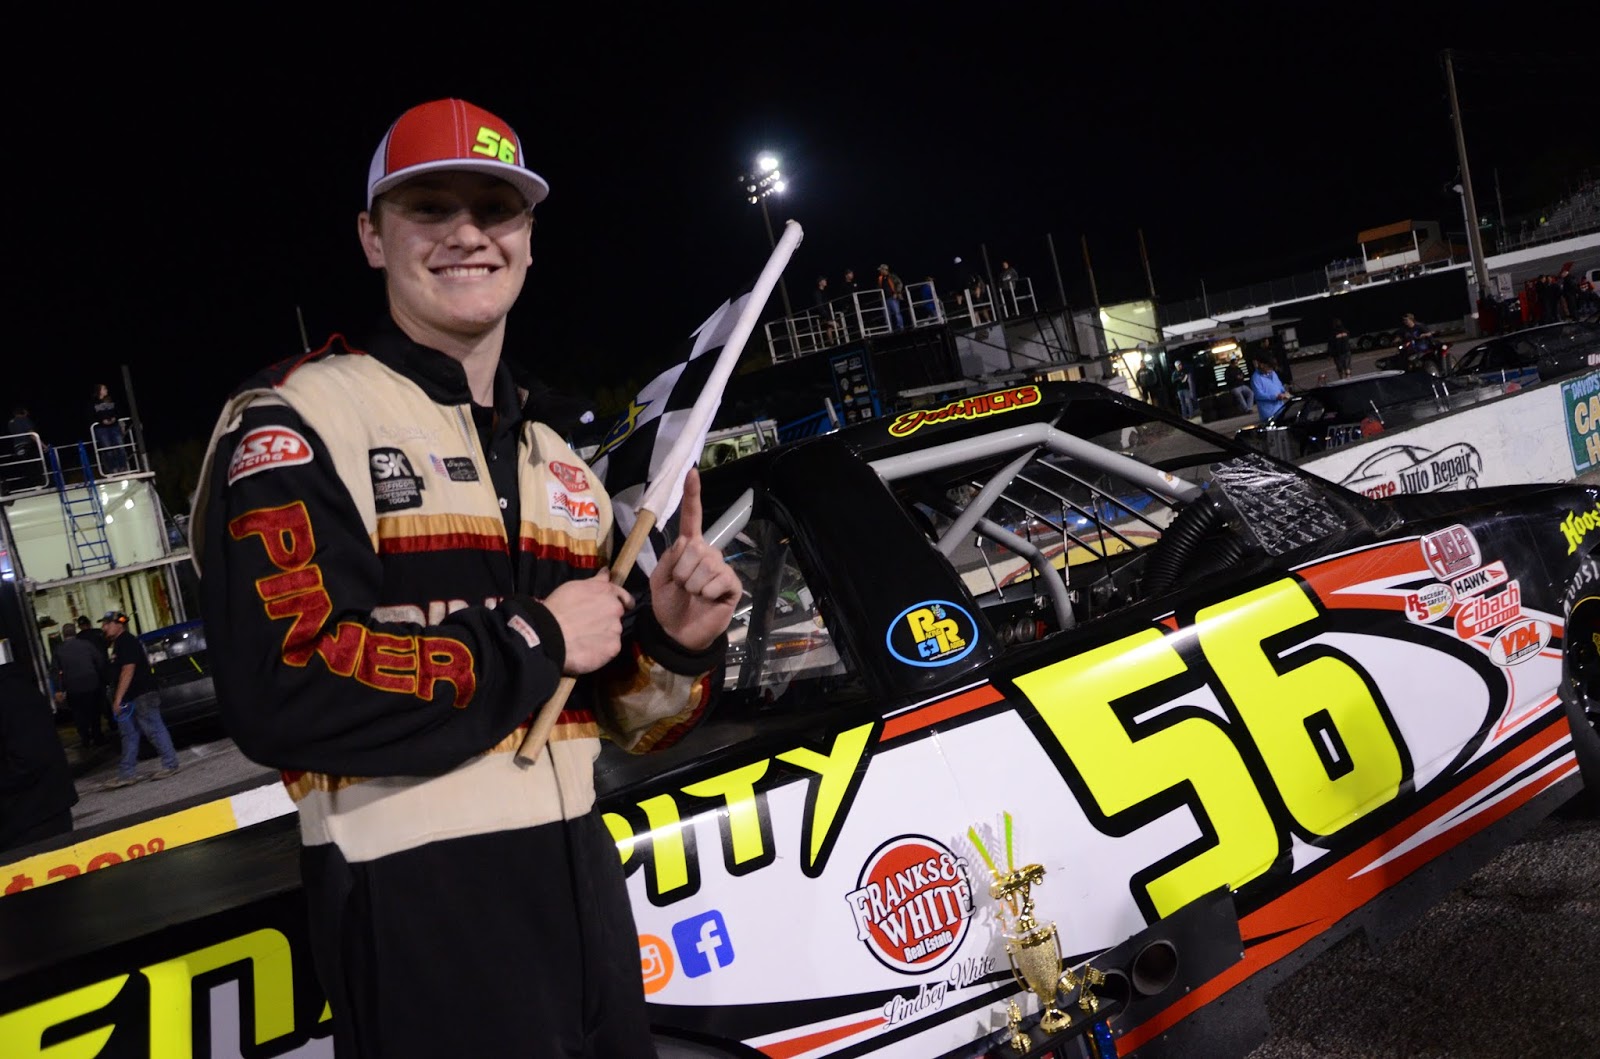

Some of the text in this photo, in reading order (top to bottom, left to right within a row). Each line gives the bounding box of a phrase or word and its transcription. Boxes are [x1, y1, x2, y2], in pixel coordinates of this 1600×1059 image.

[472, 126, 516, 164] 56
[889, 385, 1041, 436] Josh HICKS
[371, 453, 411, 479] SK
[1399, 467, 1429, 494] Auto
[1430, 448, 1471, 485] Repair
[1454, 571, 1489, 595] HAWK
[1456, 584, 1519, 639] Eibach
[1501, 621, 1540, 656] VDL
[1012, 577, 1403, 920] 56
[878, 879, 976, 948] WHITE
[904, 930, 953, 963] Real Estate
[883, 957, 996, 1030] Lindsey White
